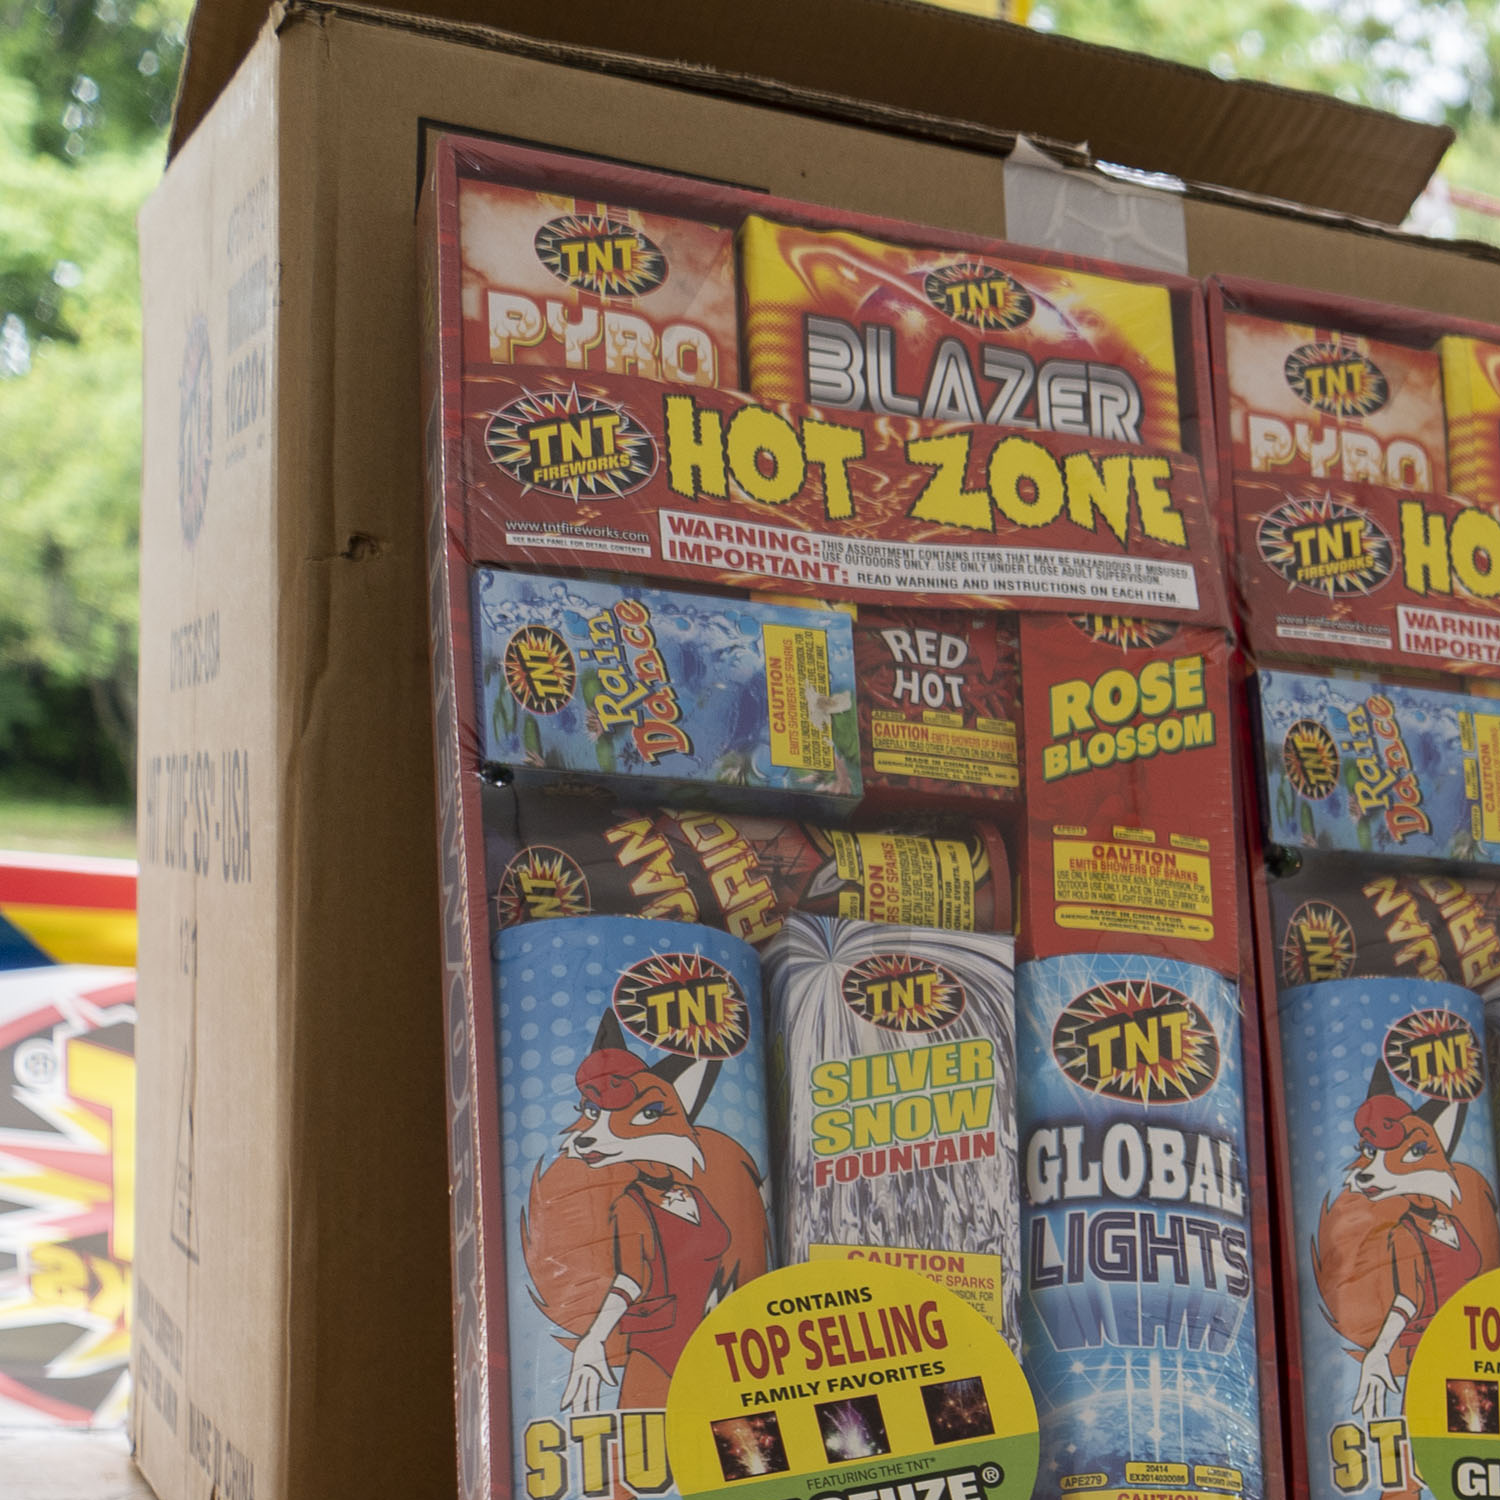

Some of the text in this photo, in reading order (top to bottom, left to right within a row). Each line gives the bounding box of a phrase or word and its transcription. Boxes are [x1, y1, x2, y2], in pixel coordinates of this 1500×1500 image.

[561, 238, 638, 275] TNT
[945, 278, 1011, 312] TNT
[487, 291, 720, 388] PYRO
[805, 315, 1143, 443] BLAZER
[1304, 361, 1368, 398] TNT
[530, 413, 622, 468] TNT
[533, 453, 631, 484] FIREWORKS
[662, 393, 1190, 551] HOT ZONE
[505, 519, 650, 543] www.tntfireworks.com
[666, 514, 821, 557] WARNING:
[1292, 518, 1368, 564] TNT
[668, 539, 850, 586] IMPORTANT:
[1297, 553, 1374, 581] FIREWORKS
[856, 572, 1181, 605] READ WARNING AND INSTRUCTIONS ON EACH ITEM.
[524, 643, 567, 699] TNT
[580, 609, 648, 733] Rain
[881, 627, 969, 670] RED
[613, 599, 692, 764] Dance
[892, 668, 965, 709] HOT
[1049, 653, 1206, 739] ROSE
[1042, 709, 1216, 783] BLOSSOM
[1299, 736, 1332, 784] TNT
[1341, 708, 1391, 816] Rain
[1366, 695, 1432, 844] Dance
[1091, 844, 1178, 868] CAUTION
[645, 982, 731, 1037] TNT
[865, 971, 940, 1014] TNT
[1086, 1007, 1190, 1076] TNT
[1409, 1031, 1471, 1079] TNT
[810, 1038, 995, 1107] SILVER
[810, 1084, 997, 1157] SNOW
[813, 1131, 997, 1189] FOUNTAIN
[1025, 1122, 1247, 1209] GLOBAL
[1029, 1207, 1251, 1301] LIGHTS
[765, 1285, 874, 1317] CONTAINS
[714, 1299, 950, 1385] TOP SELLING
[739, 1360, 947, 1408] FAMILY FAVORITES
[805, 1467, 880, 1491] FEATURING
[879, 1462, 904, 1480] THE
[1063, 1475, 1103, 1488] APE279
